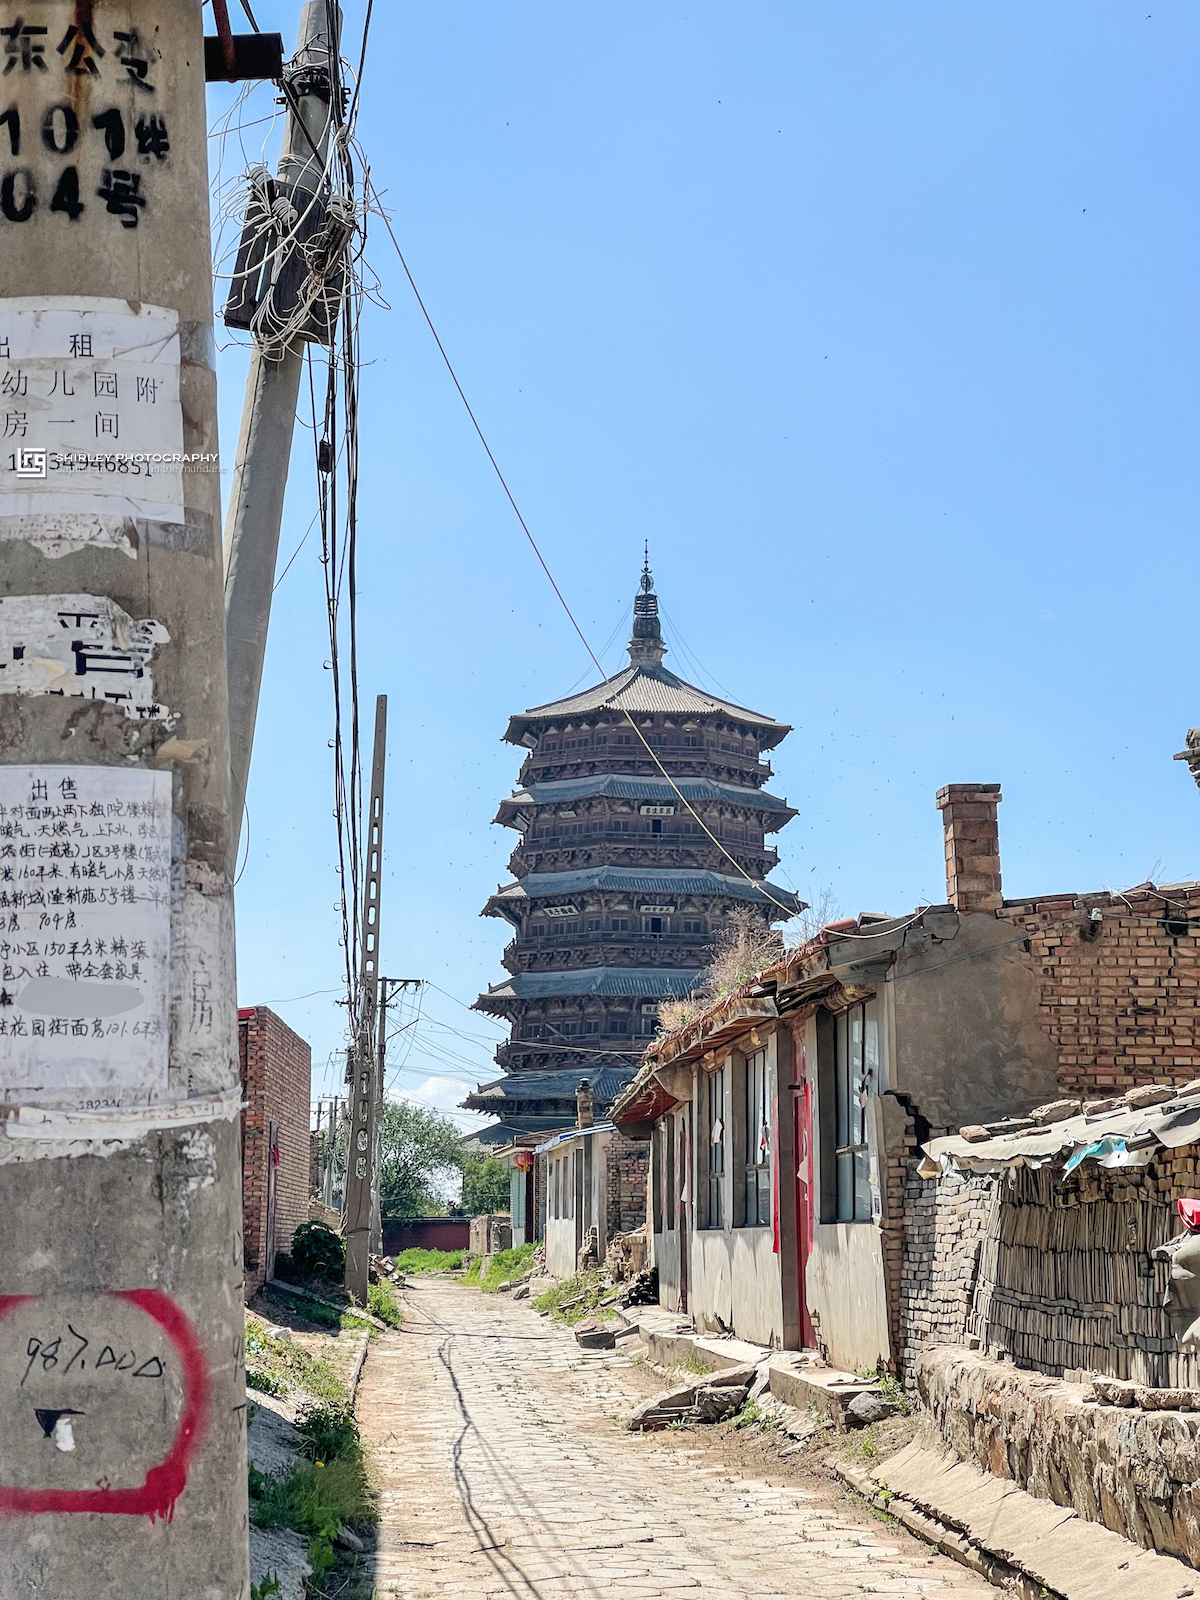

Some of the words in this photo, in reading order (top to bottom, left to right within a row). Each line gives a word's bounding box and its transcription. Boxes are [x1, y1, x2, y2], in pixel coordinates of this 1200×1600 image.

[1, 370, 158, 404] 幼儿园附
[3, 410, 119, 439] 房一间
[31, 776, 78, 801] 出售
